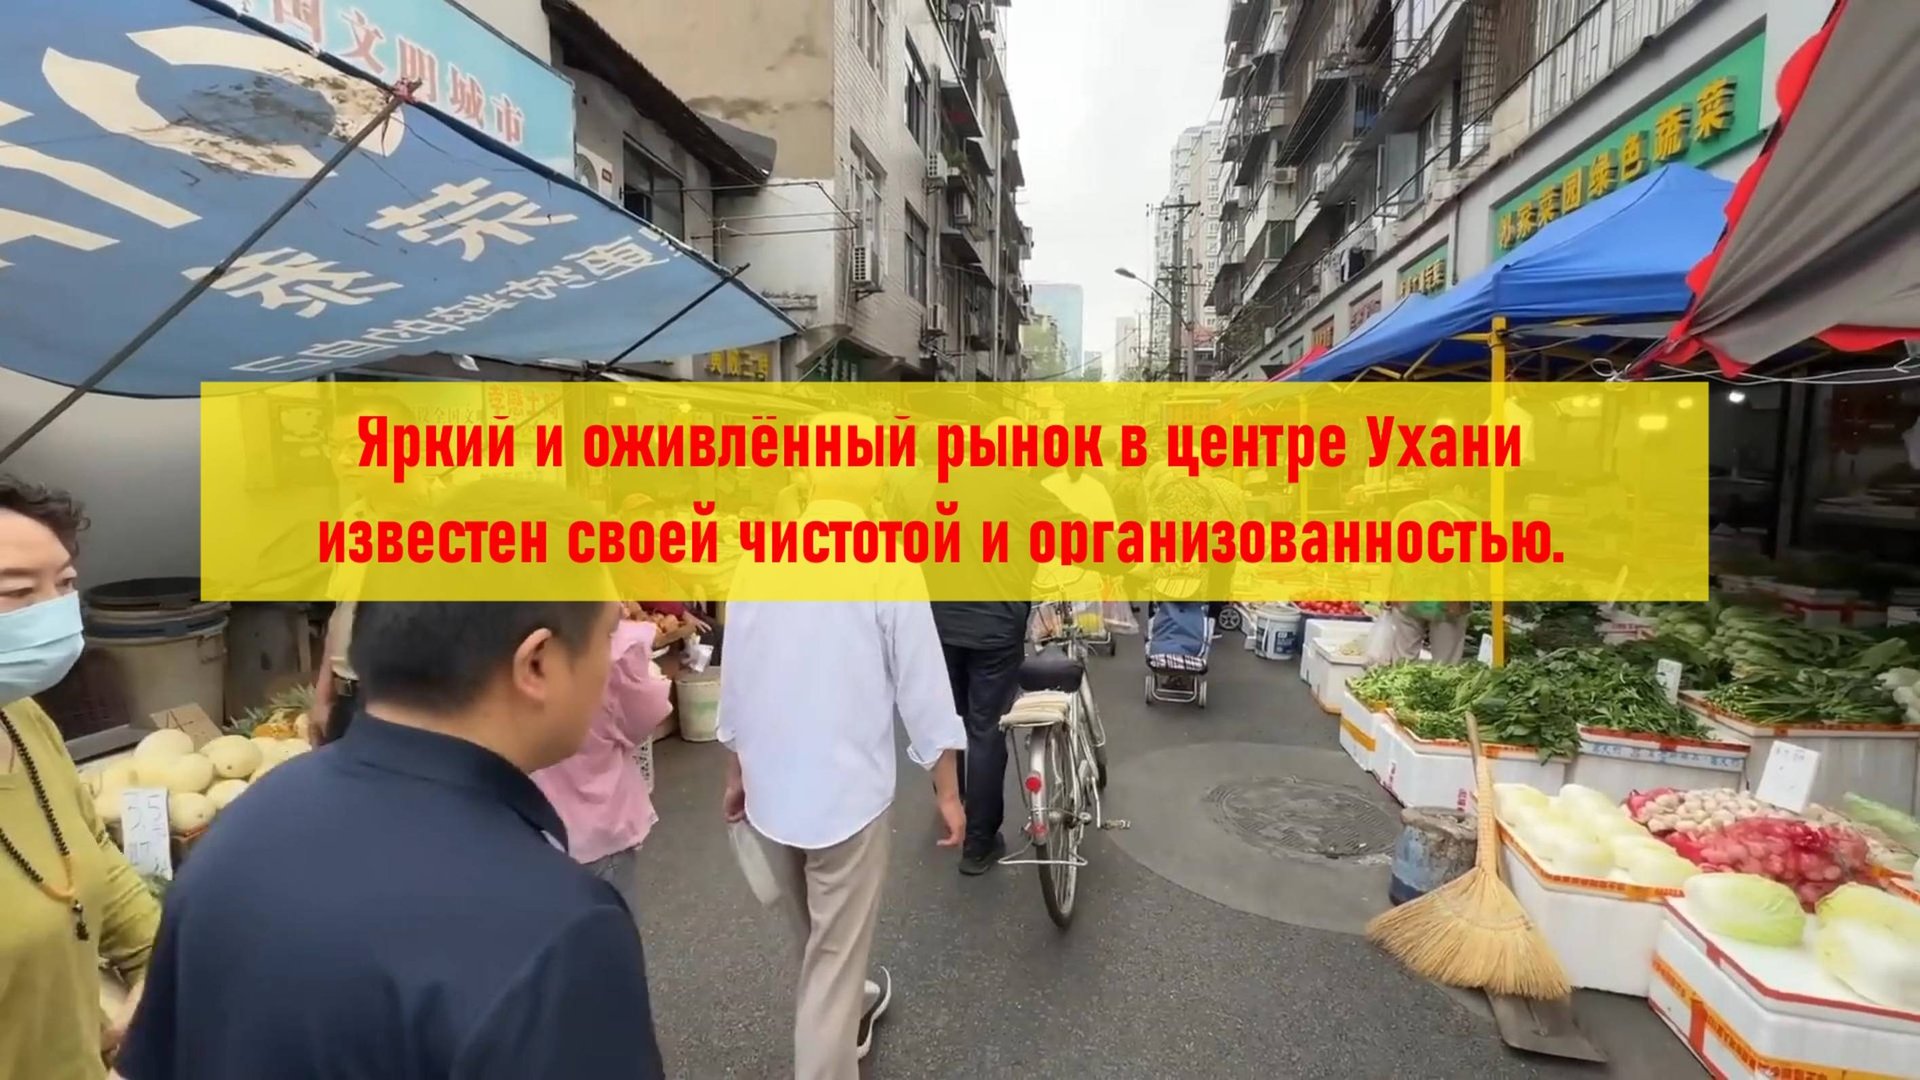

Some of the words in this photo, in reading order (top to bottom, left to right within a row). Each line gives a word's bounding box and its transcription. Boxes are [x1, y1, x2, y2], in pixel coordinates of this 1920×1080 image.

[238, 0, 526, 144] 国文明城市
